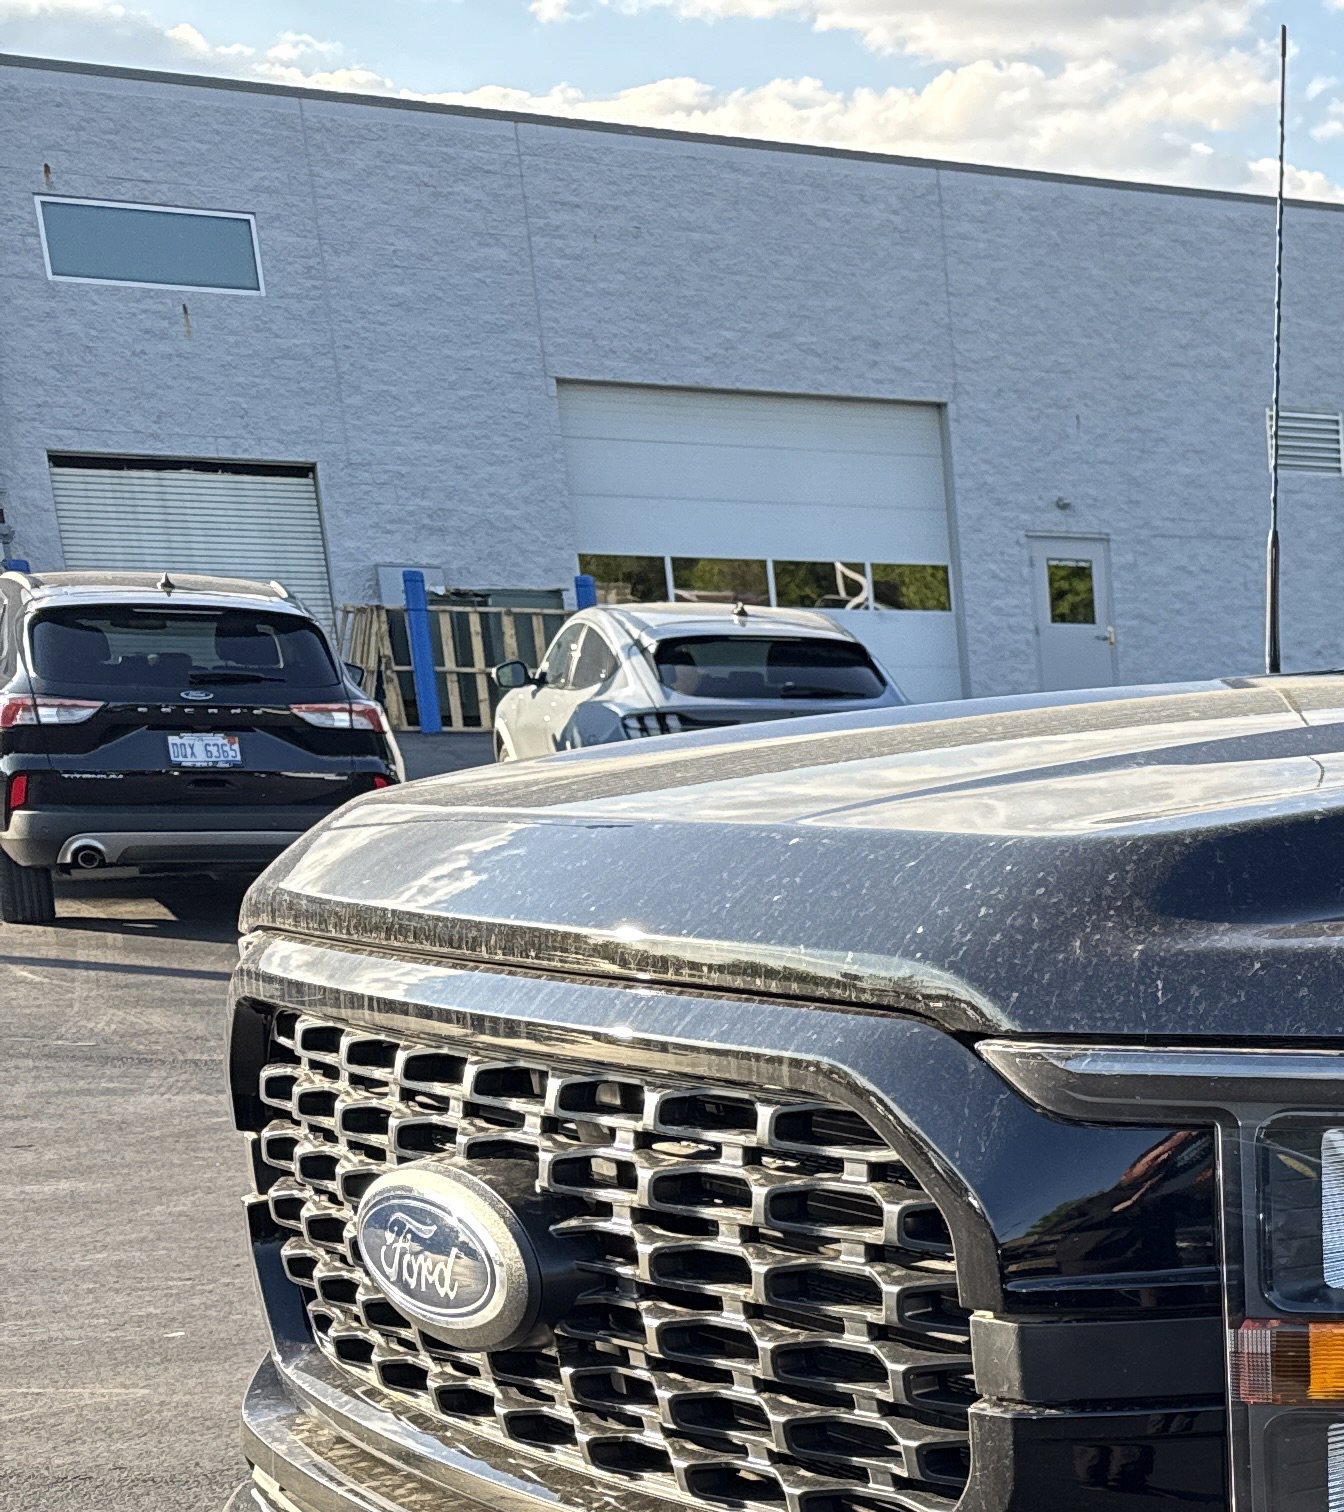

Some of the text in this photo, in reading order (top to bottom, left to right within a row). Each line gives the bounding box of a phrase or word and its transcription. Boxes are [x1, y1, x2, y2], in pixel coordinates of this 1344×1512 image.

[171, 742, 238, 759] DQX 6365
[380, 1211, 463, 1301] Ford
